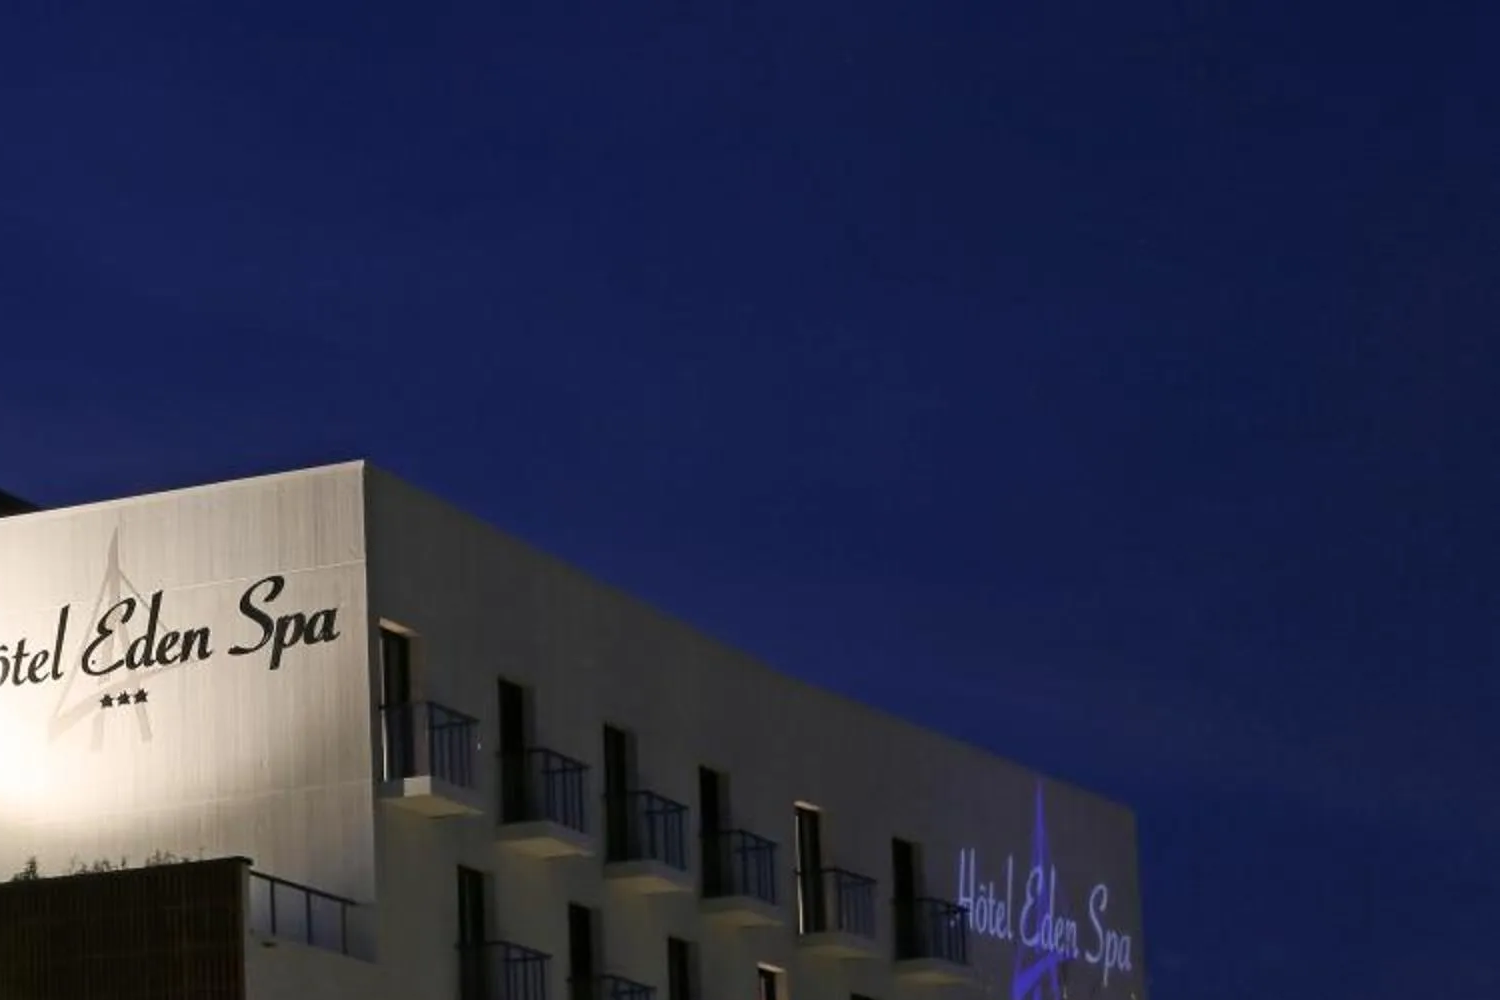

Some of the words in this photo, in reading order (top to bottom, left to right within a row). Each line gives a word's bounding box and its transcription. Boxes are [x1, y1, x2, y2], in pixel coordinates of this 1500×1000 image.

[81, 589, 213, 677] Eden
[227, 574, 341, 670] Spa
[951, 848, 1013, 940] Hôtel
[1019, 864, 1080, 959] Eden
[1084, 883, 1133, 987] Spa
